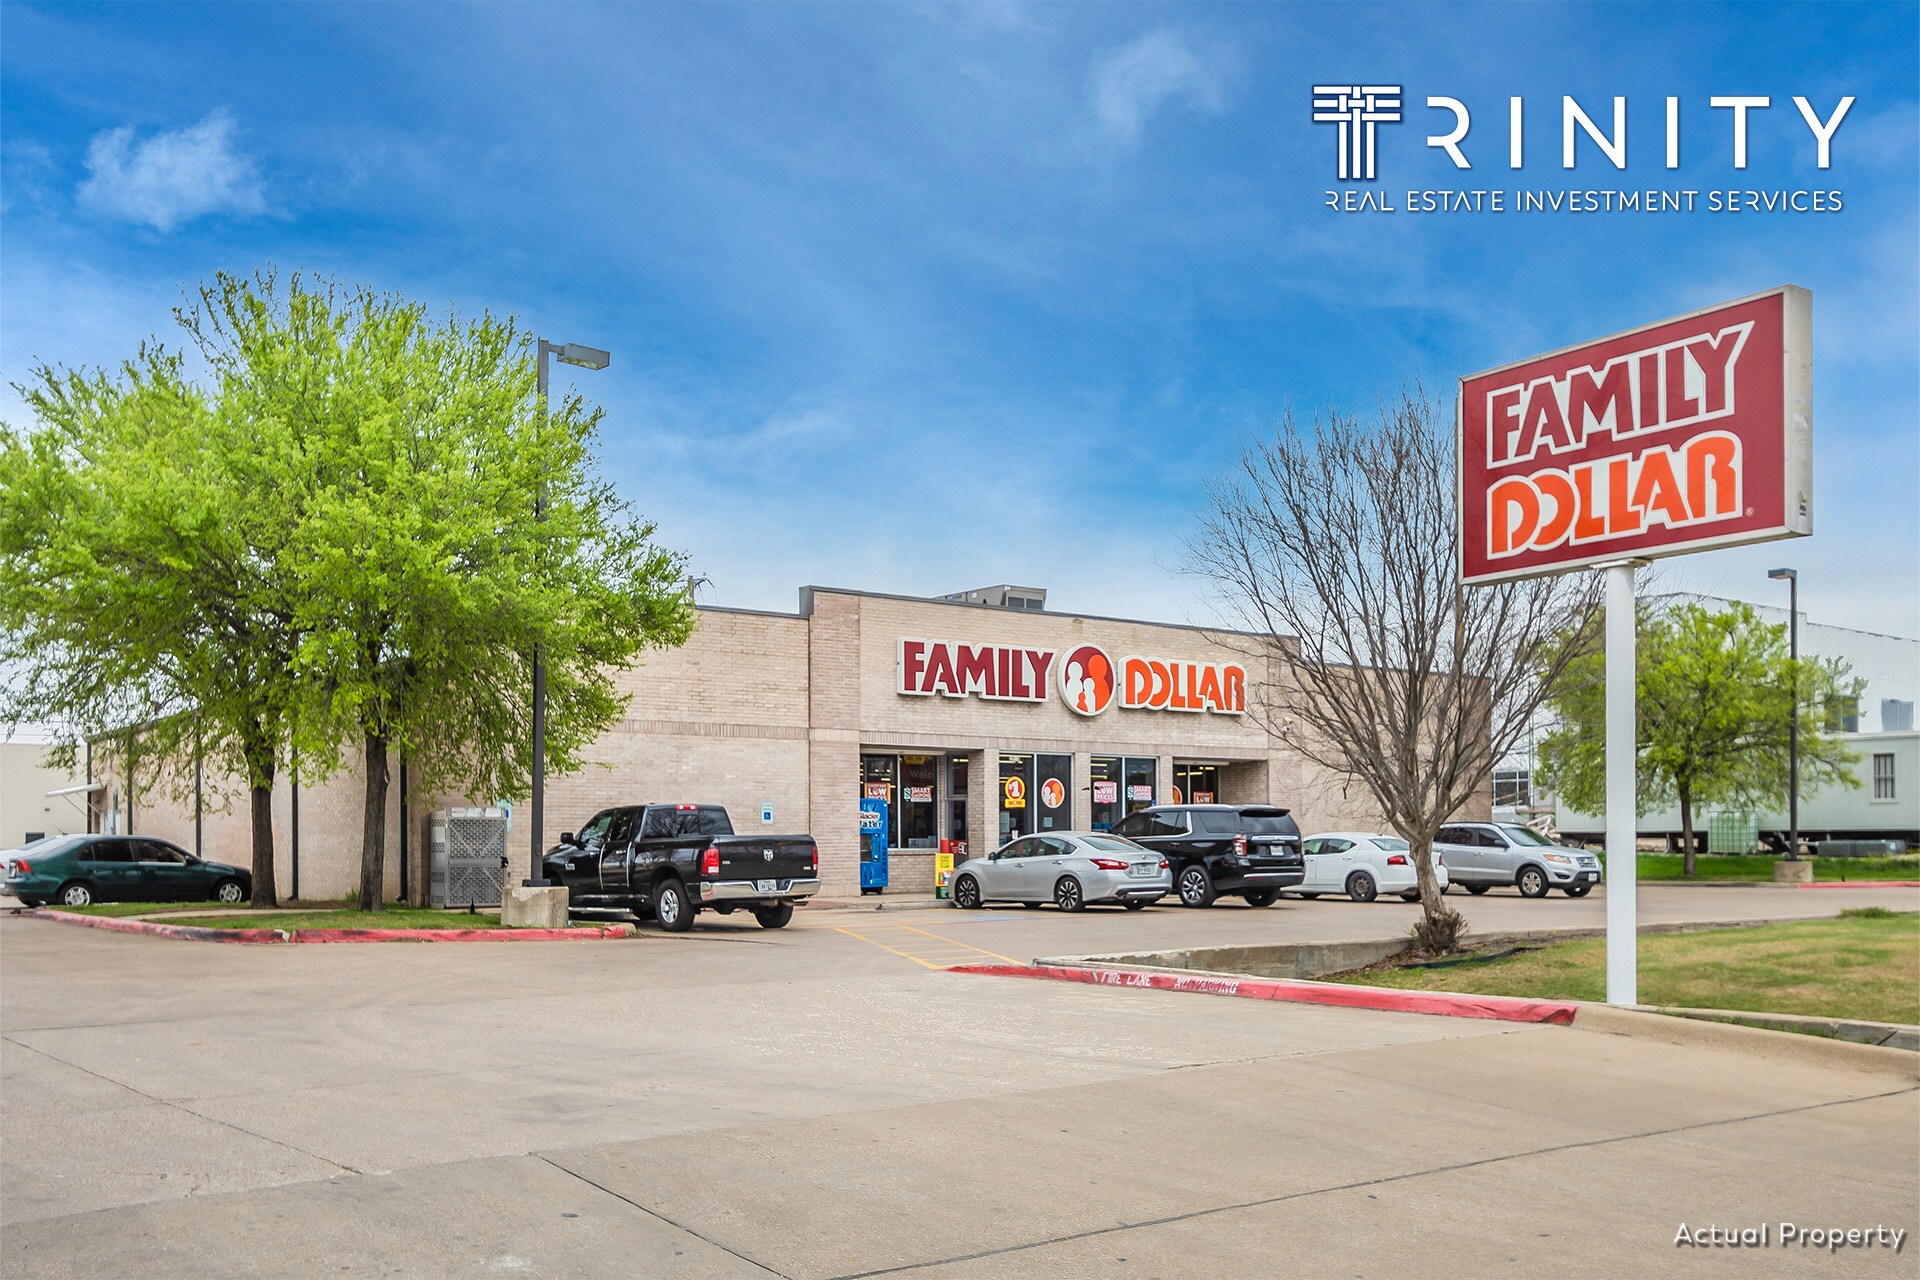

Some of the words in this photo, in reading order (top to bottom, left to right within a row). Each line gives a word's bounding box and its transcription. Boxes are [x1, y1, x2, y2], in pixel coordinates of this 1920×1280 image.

[1488, 321, 1755, 468] FAMILY
[1487, 431, 1742, 560] DOLLAR
[899, 639, 1055, 701] FAMILY
[1120, 656, 1246, 712] DOLLAR
[868, 787, 887, 796] LOW
[1126, 974, 1152, 986] LANE
